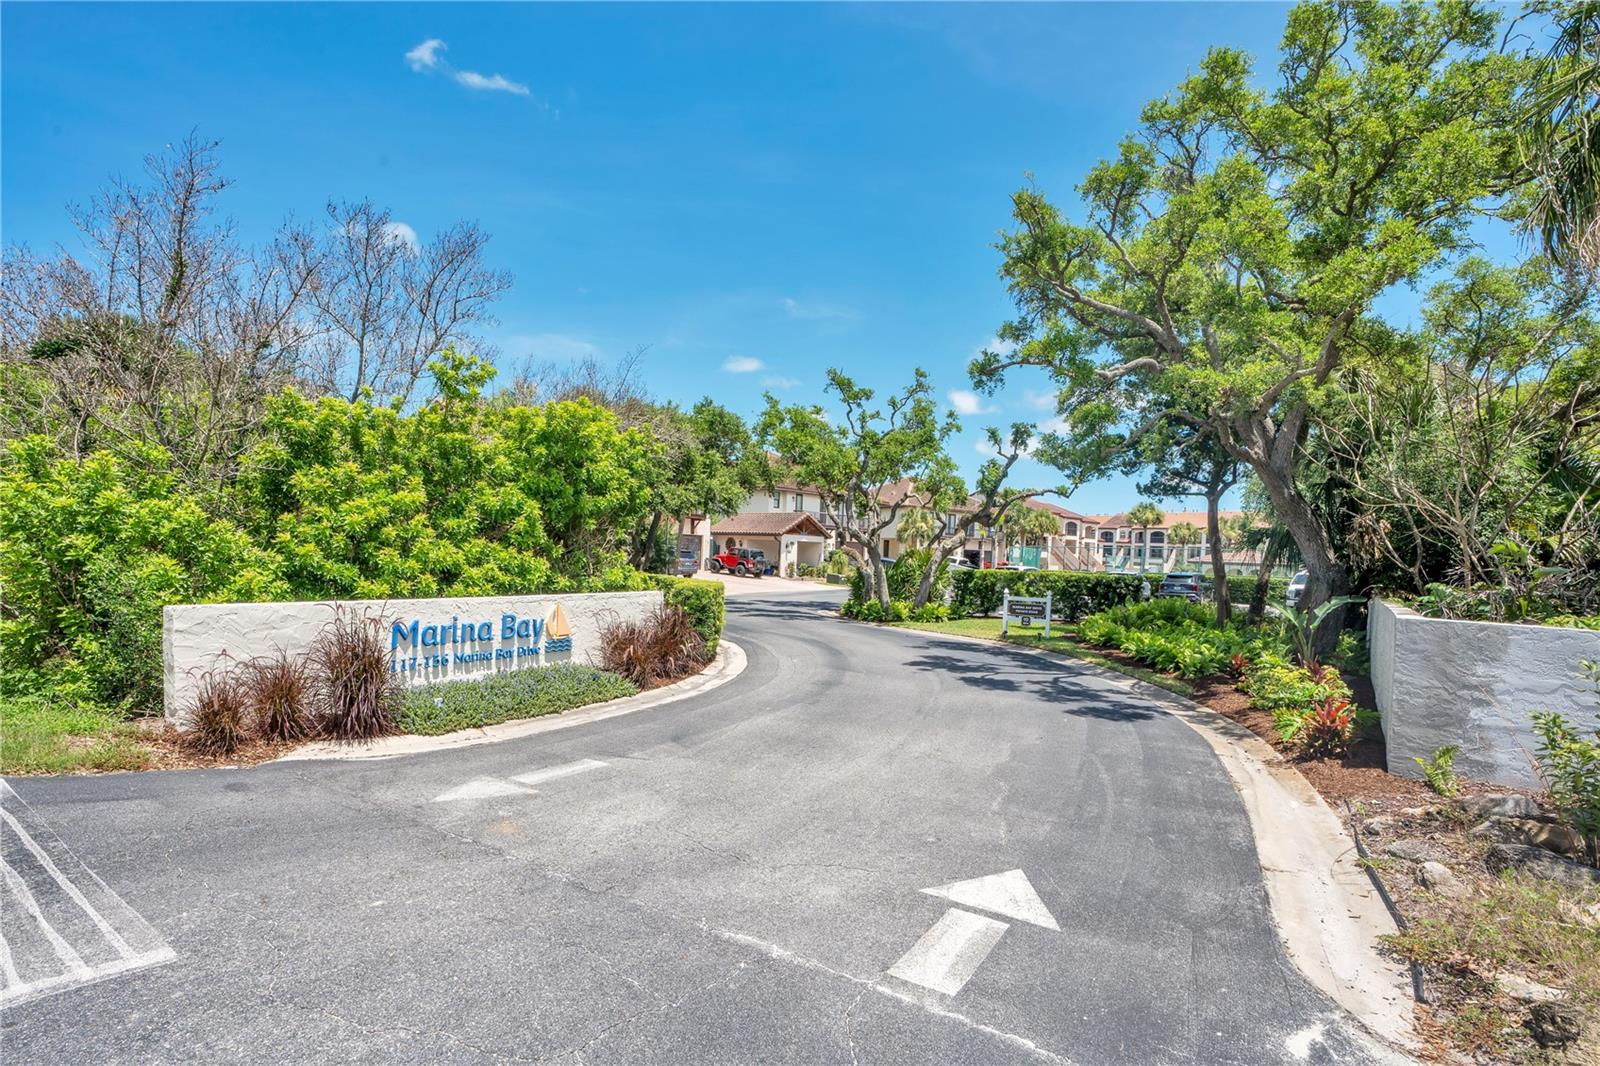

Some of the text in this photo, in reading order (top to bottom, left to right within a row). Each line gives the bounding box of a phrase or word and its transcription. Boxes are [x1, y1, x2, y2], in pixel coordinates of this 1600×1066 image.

[391, 611, 544, 650] Marina Bay
[390, 645, 541, 673] 117-156 Marina Bay Drive
